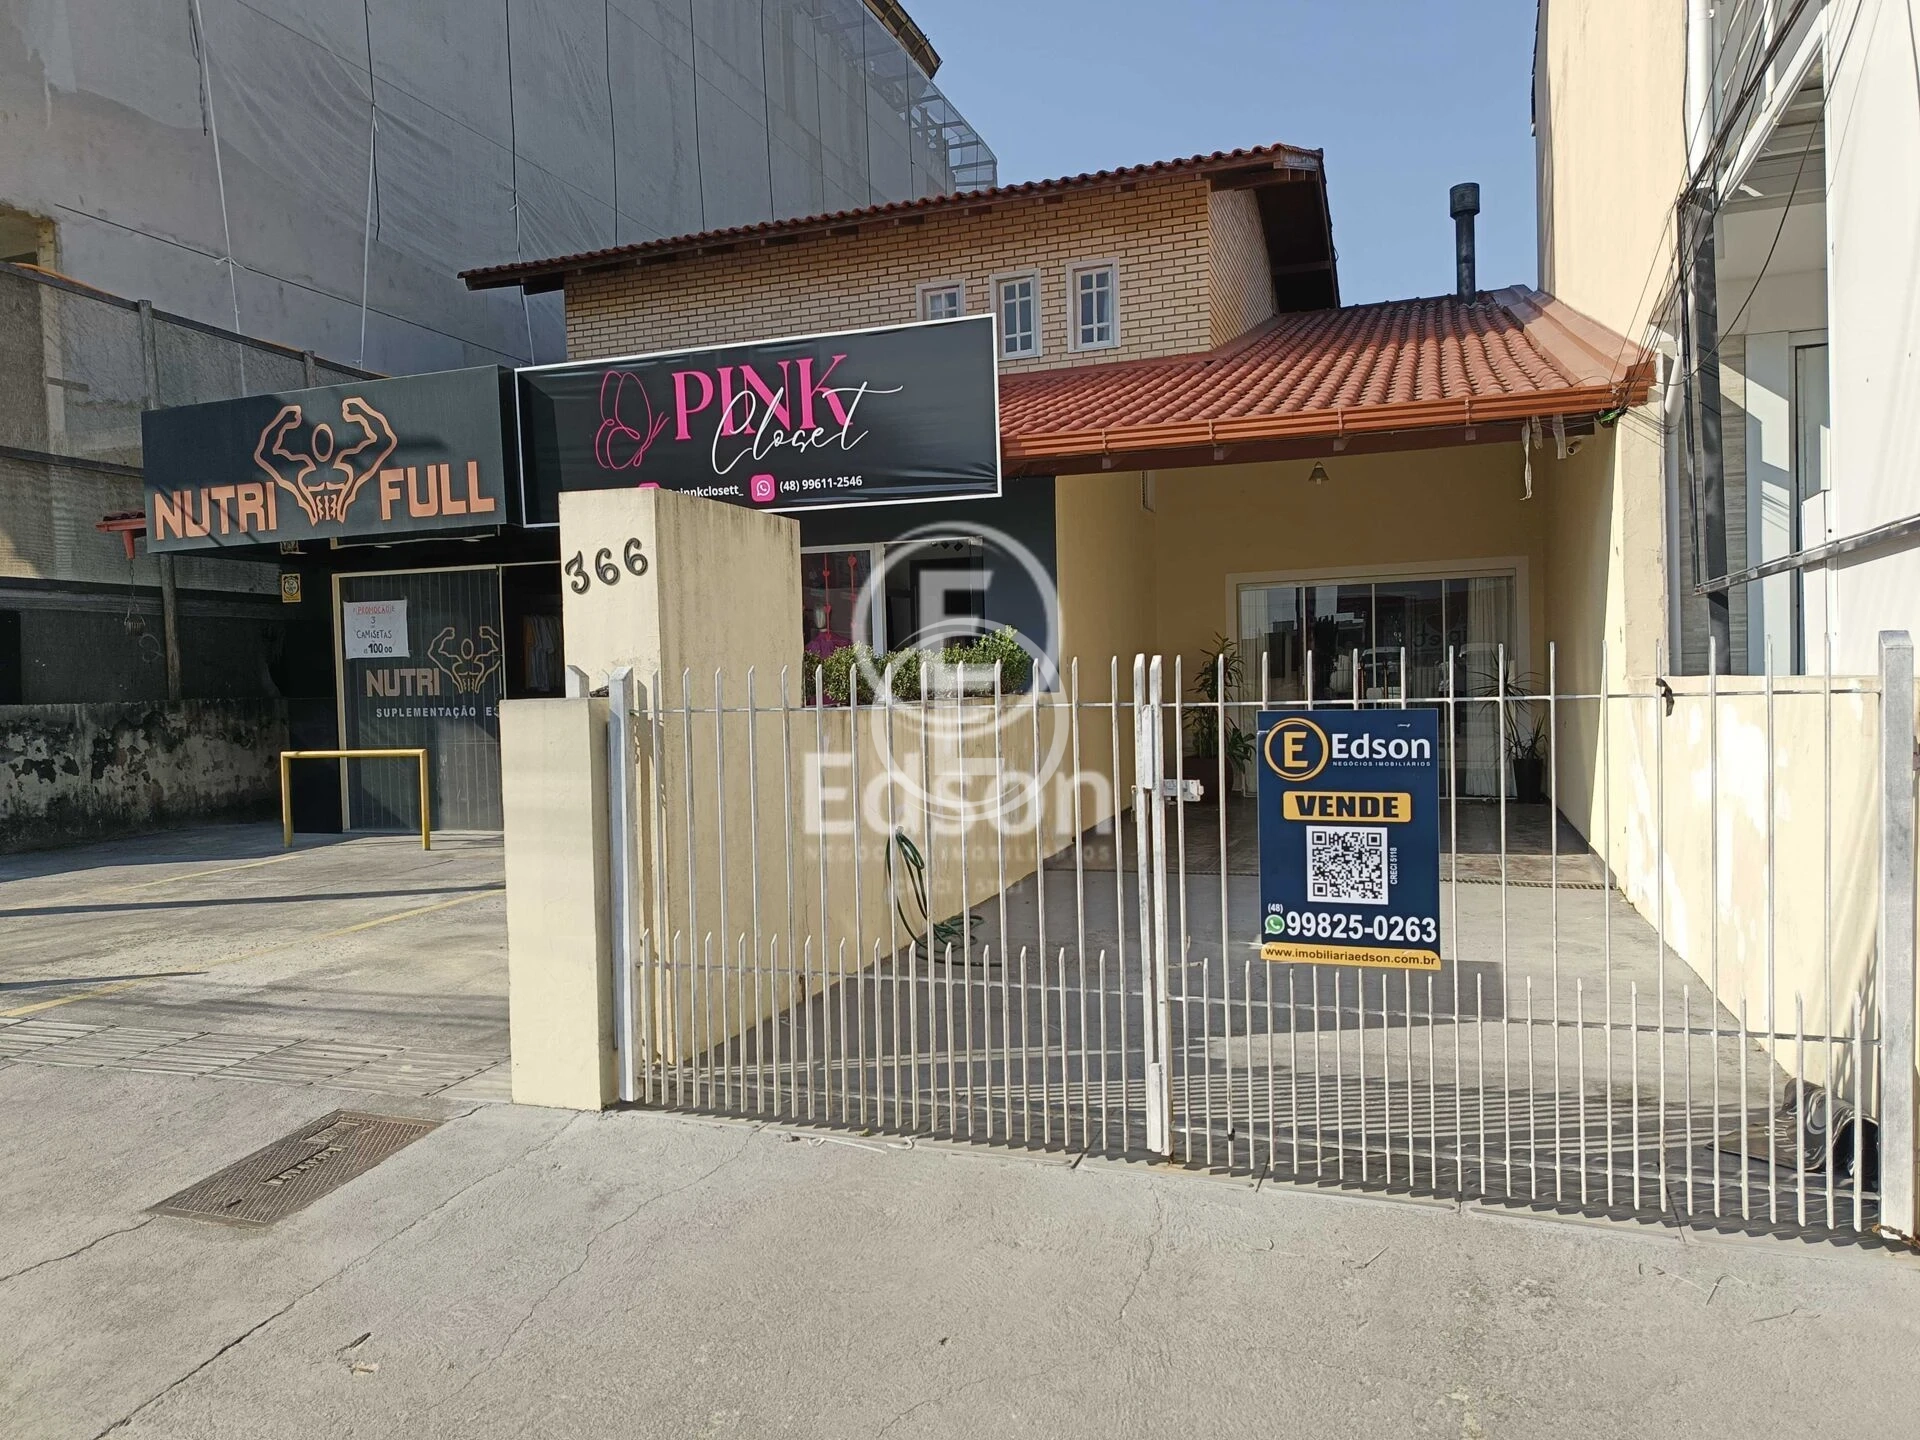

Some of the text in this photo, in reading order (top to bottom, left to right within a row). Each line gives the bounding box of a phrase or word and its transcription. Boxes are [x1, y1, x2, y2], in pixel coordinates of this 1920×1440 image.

[672, 354, 853, 440] PINK
[712, 381, 903, 475] Closet
[779, 480, 800, 494] (48)
[801, 475, 863, 491] 99611-2546
[154, 461, 495, 541] NUTRI FULL
[564, 537, 649, 594] 366
[370, 616, 376, 624] 3
[356, 629, 393, 639] CAMISETAS
[366, 668, 440, 697] NUTRI
[376, 704, 476, 719] SUPLEMENTAÇÃO
[1283, 731, 1431, 768] E Edson
[1295, 795, 1399, 818] VENDE
[1390, 863, 1398, 885] CRECI
[1267, 903, 1284, 914] (48)
[1286, 911, 1437, 943] 99825-0263
[1265, 948, 1436, 966] www.imobiliariaedson.com.br
